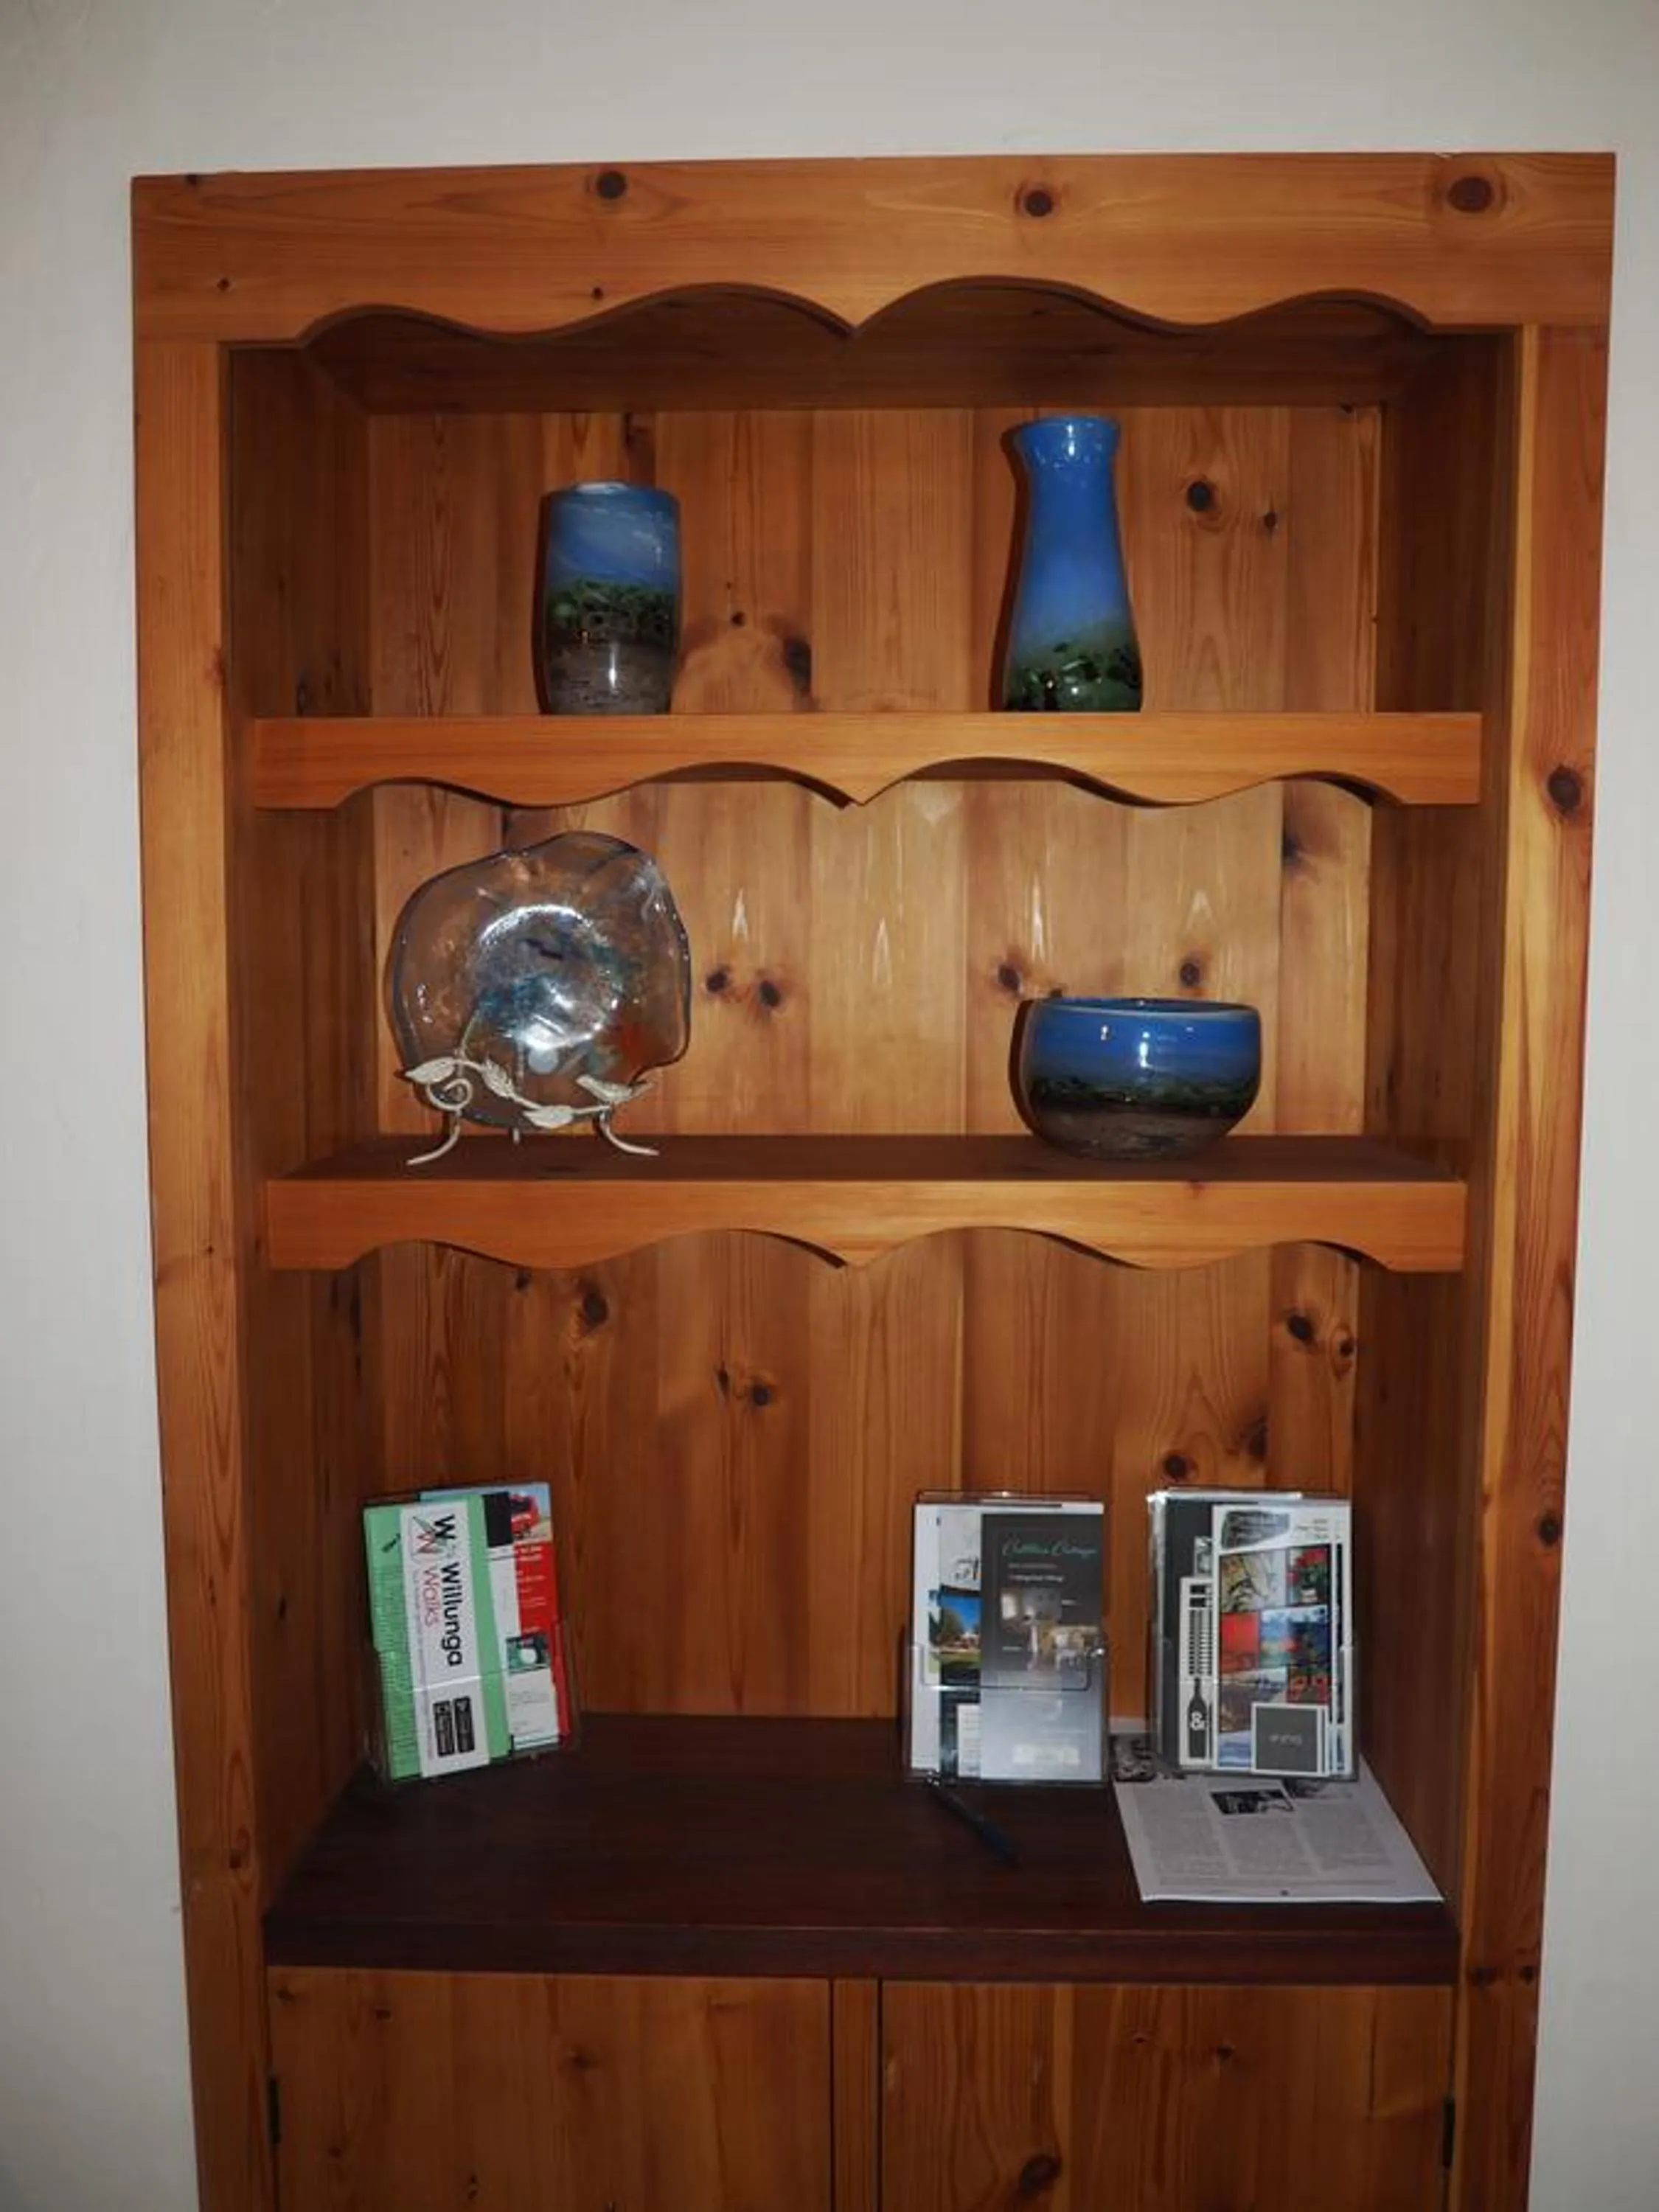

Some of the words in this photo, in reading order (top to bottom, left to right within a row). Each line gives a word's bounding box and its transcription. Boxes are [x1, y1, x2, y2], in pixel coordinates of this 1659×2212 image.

[423, 1566, 440, 1627] Walks
[441, 1562, 463, 1666] Willunga
[1189, 1712, 1206, 1731] &
